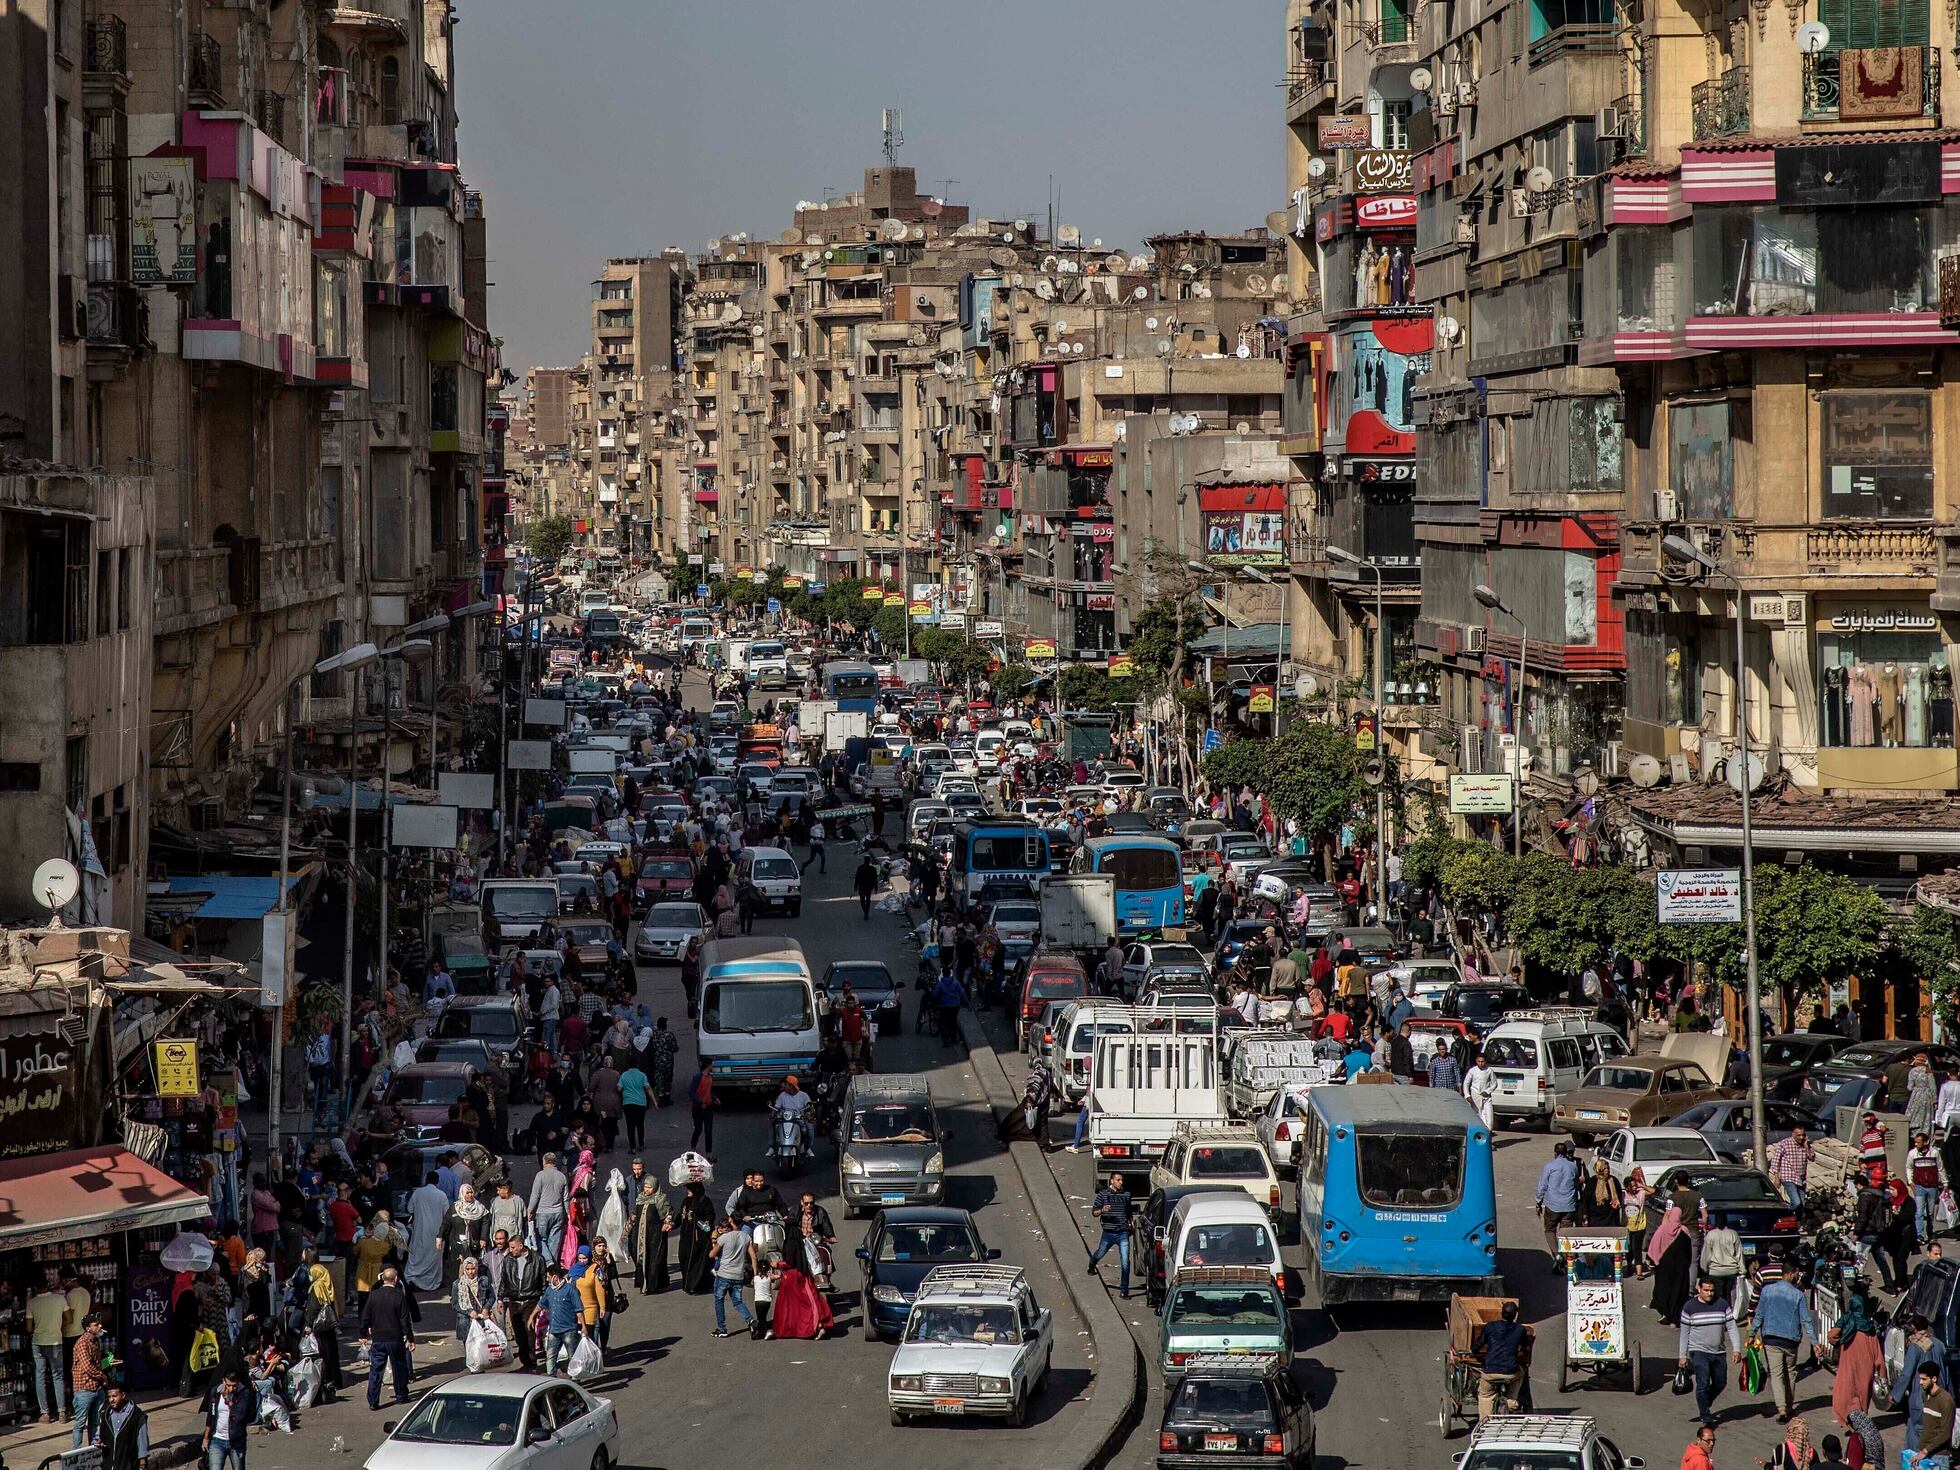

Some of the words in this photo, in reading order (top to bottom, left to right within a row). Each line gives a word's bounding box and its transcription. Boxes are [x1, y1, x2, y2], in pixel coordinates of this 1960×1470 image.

[1373, 434, 1399, 450] القمر
[983, 873, 1036, 881] HASSAAN
[1709, 885, 1728, 897] خالد
[13, 1042, 68, 1083] عطور
[131, 1298, 168, 1314] Dairy
[133, 1312, 167, 1327] Milk
